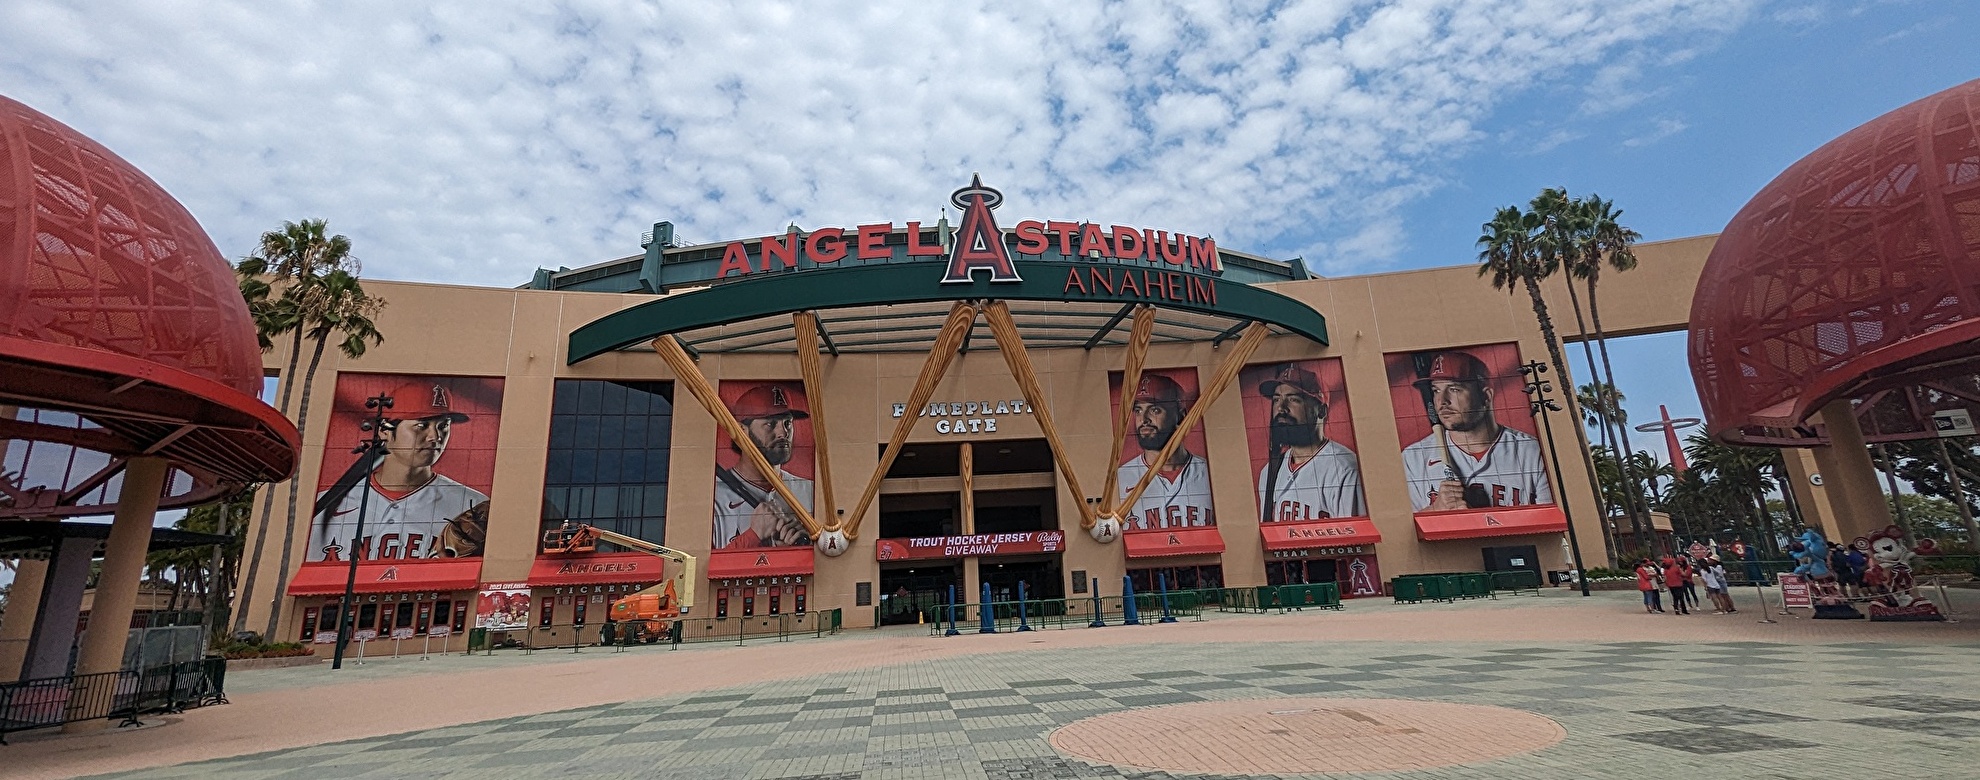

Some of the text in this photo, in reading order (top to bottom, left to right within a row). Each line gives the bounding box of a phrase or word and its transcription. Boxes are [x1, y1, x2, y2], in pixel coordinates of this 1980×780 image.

[717, 221, 944, 279] ANGEL
[1015, 219, 1222, 272] STADIUM
[1064, 266, 1217, 305] ANAHEIM
[892, 400, 1034, 417] HMEPLAT
[936, 418, 997, 434] GATE
[1287, 525, 1356, 539] ANGELS
[909, 533, 1033, 548] TROUT HOCKEY JERSEY
[944, 545, 999, 555] GIVEAWAY
[1273, 547, 1363, 558] TEAM STORE
[557, 562, 637, 574] ANGELS
[723, 576, 802, 587] TICKETS
[555, 584, 641, 595] TICKETS
[339, 592, 439, 604] TICKETS
